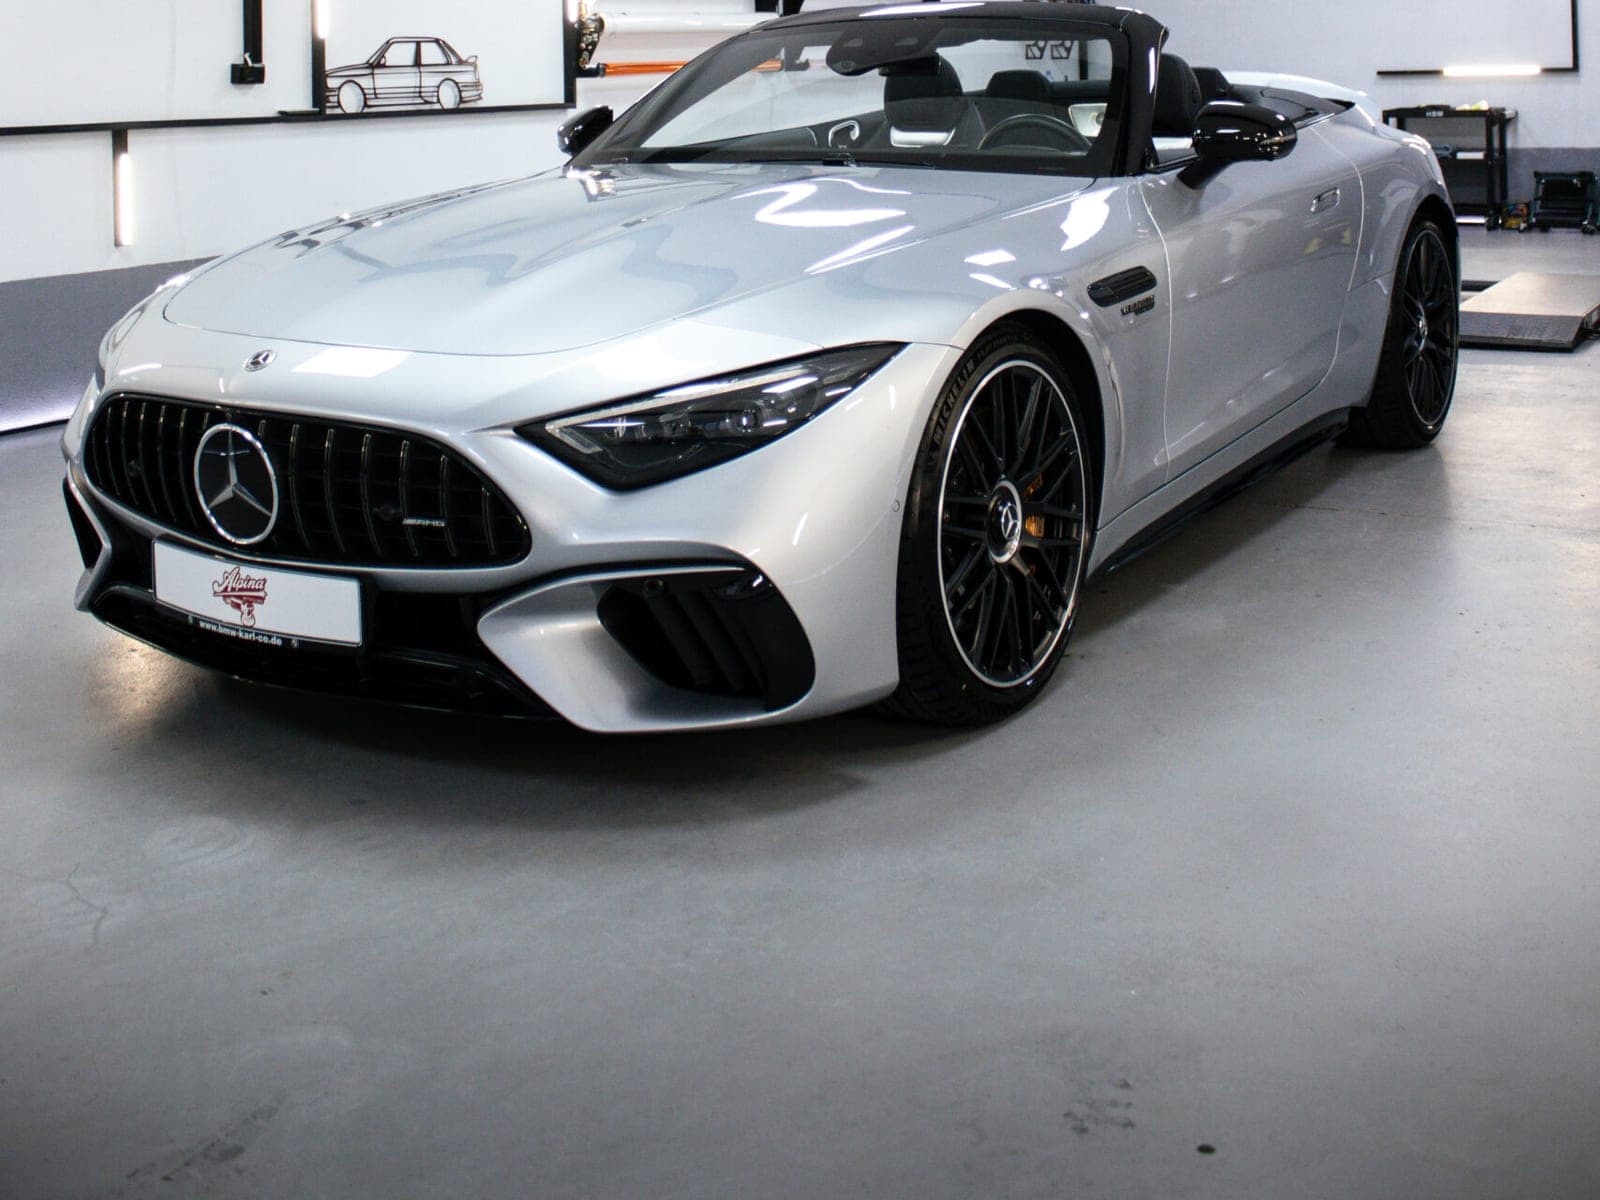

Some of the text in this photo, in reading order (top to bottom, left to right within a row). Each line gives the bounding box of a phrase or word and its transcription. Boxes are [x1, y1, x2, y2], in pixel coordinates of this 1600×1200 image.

[932, 359, 976, 445] MICHELIN
[413, 519, 445, 527] AMG
[212, 566, 267, 592] Alpina
